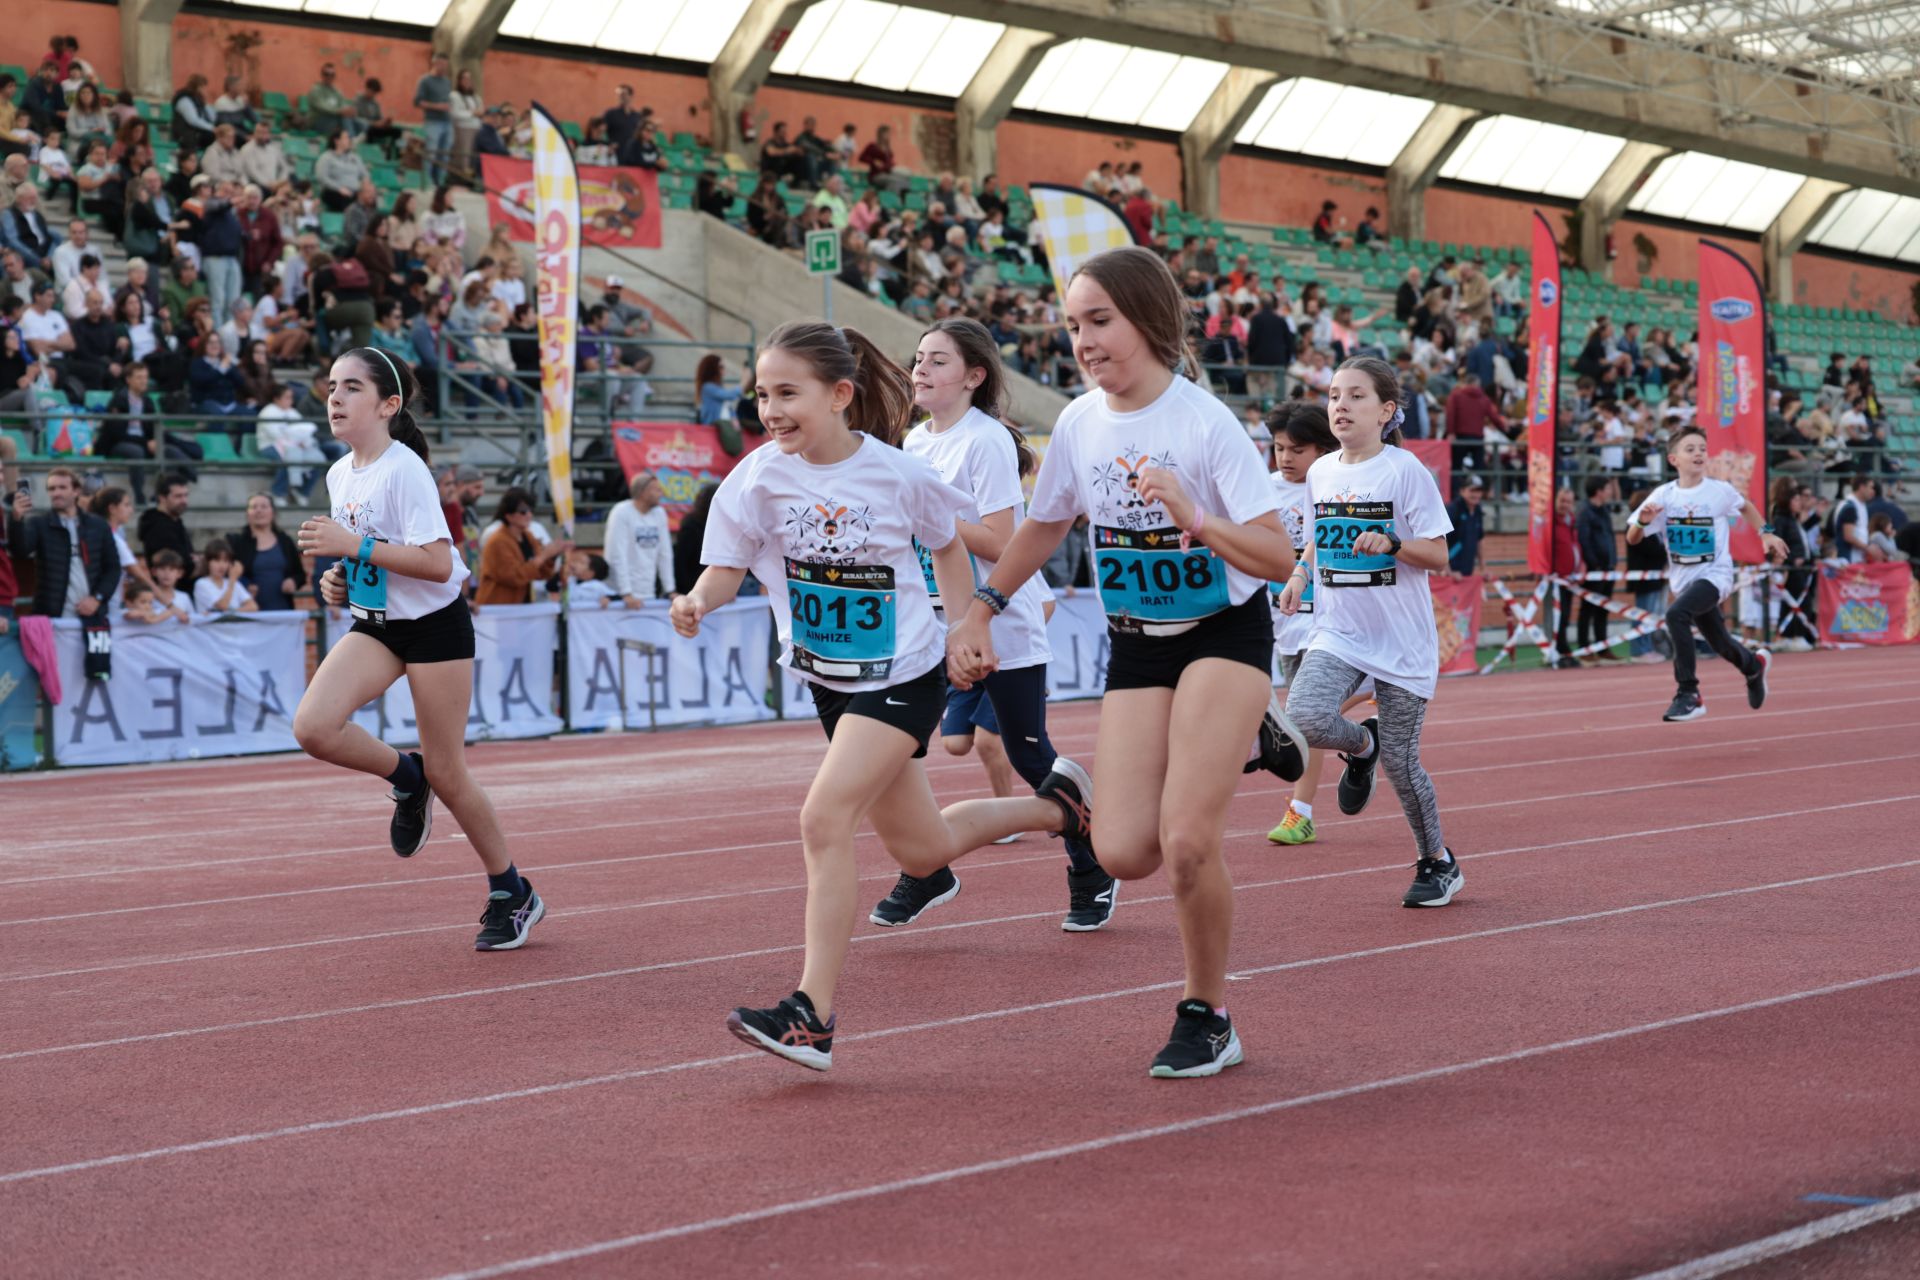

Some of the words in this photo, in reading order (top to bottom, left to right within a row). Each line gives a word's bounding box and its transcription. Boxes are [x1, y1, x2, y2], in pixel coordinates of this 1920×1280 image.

[1144, 511, 1164, 526] 17
[1668, 529, 1710, 544] 2112
[1100, 554, 1213, 592] 2108
[1140, 595, 1174, 606] IRATI
[790, 588, 883, 631] 2013
[805, 630, 853, 643] AINHIZE
